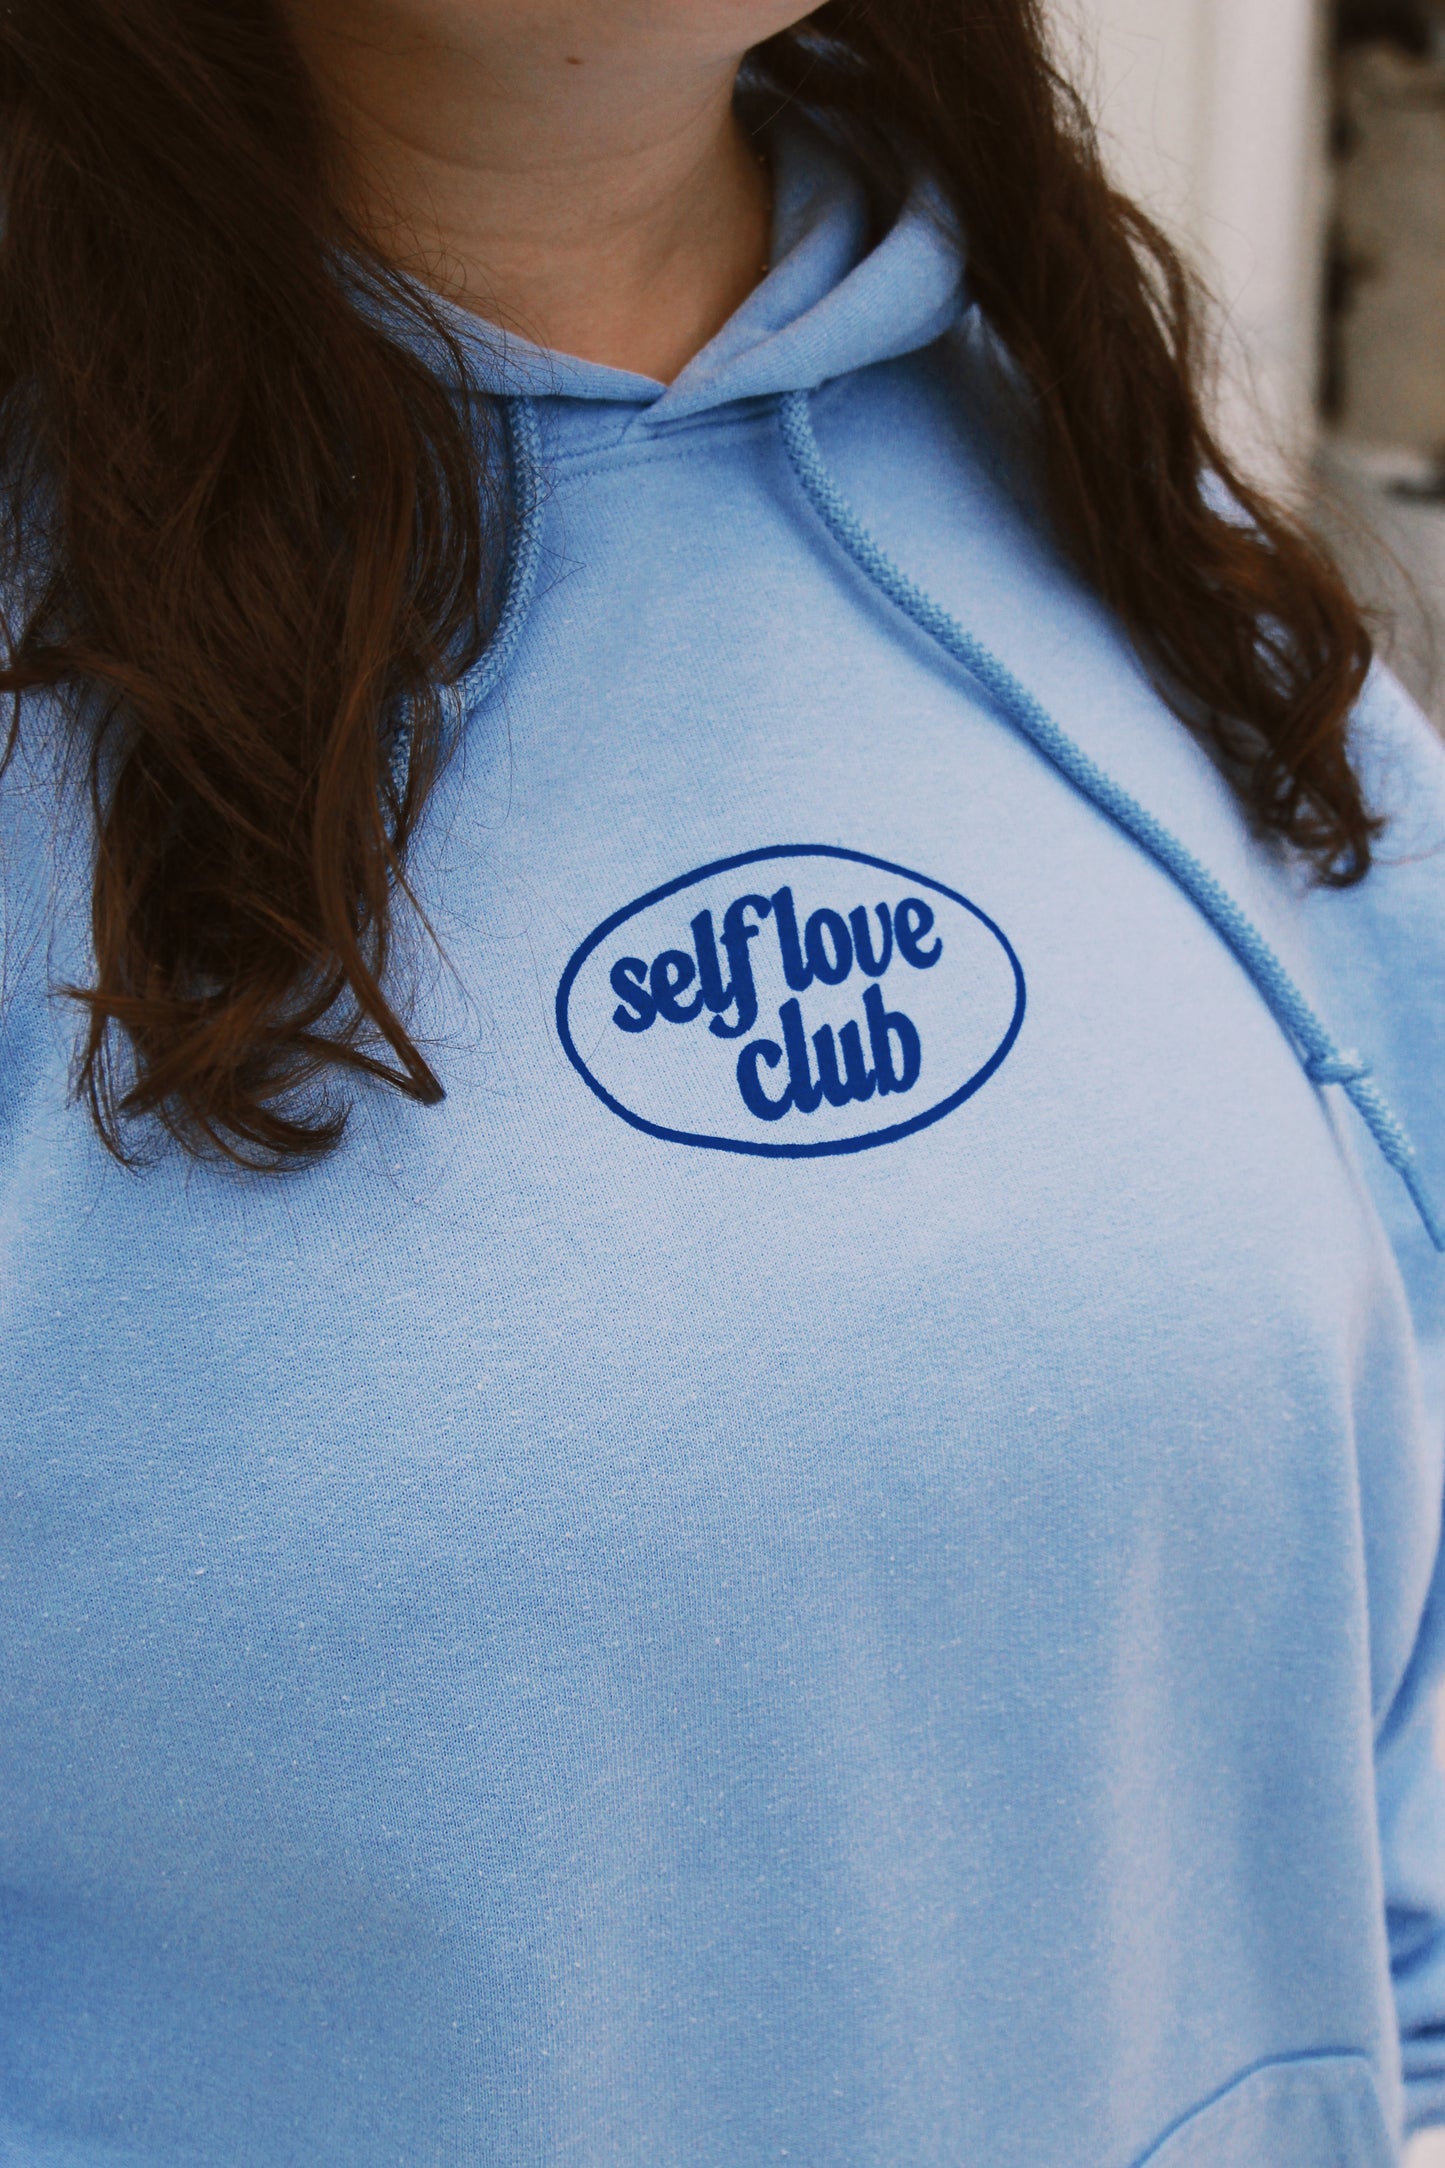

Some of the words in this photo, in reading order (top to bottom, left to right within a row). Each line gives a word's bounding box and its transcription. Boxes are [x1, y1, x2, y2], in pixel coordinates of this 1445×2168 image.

[609, 894, 772, 1039] self
[771, 886, 943, 991] love
[736, 983, 921, 1121] club
